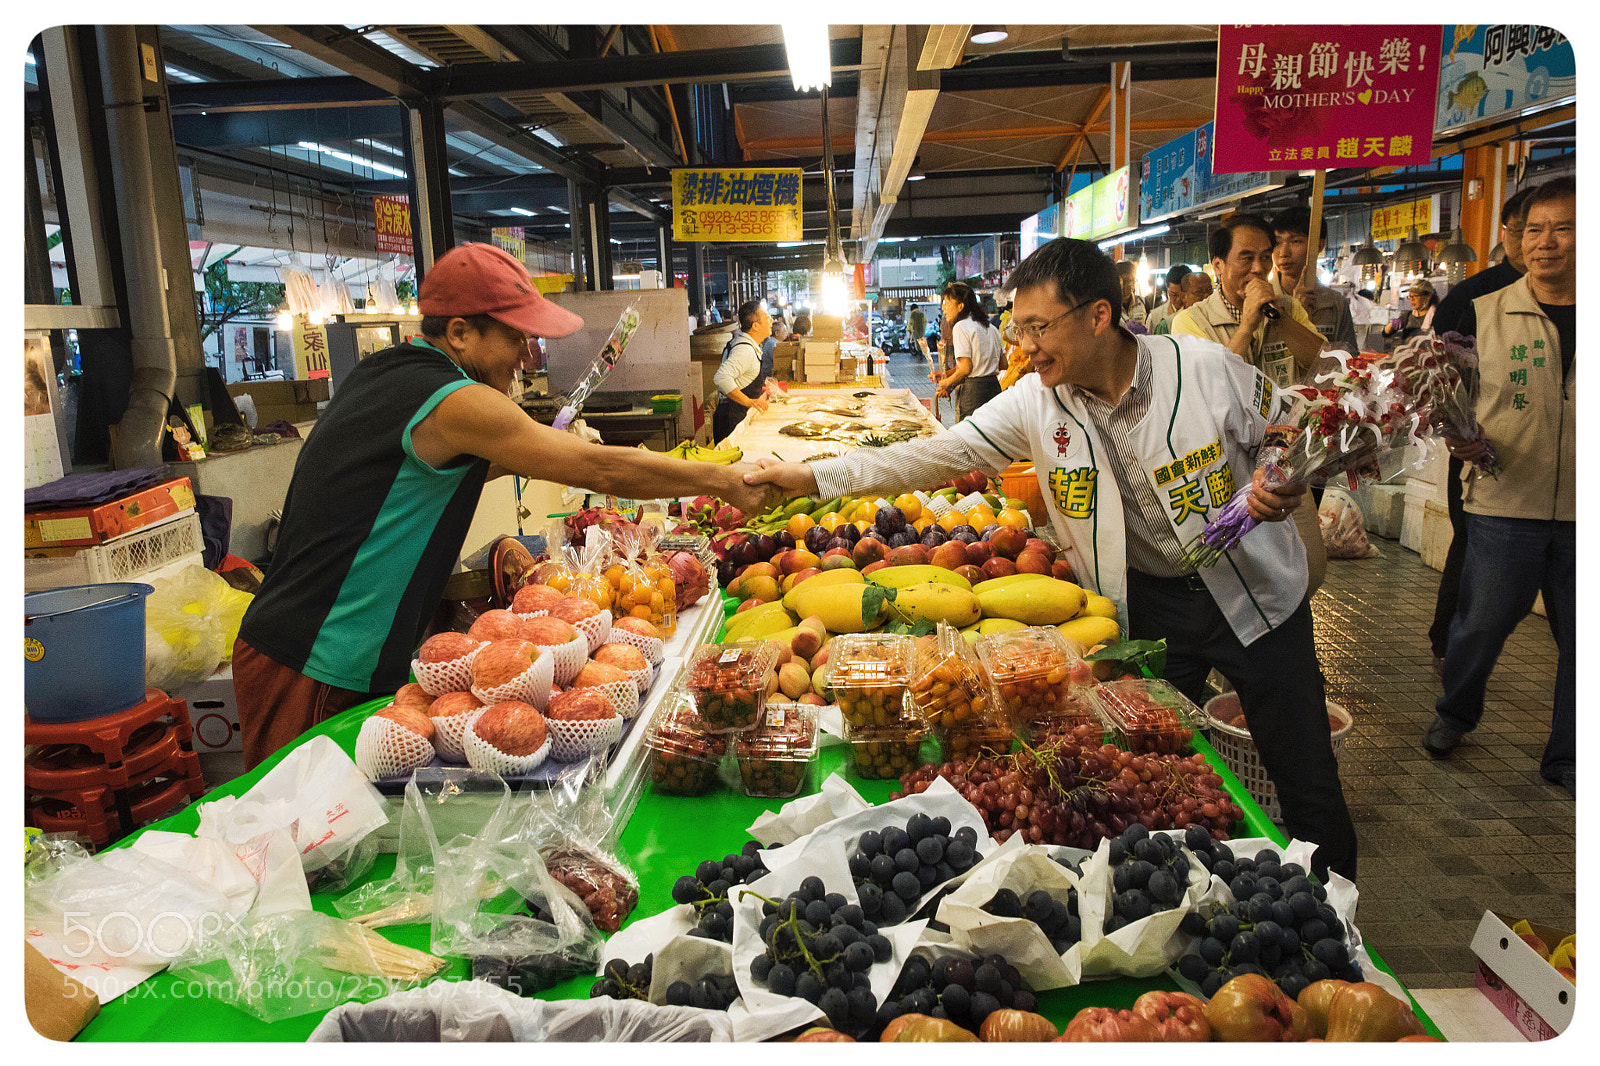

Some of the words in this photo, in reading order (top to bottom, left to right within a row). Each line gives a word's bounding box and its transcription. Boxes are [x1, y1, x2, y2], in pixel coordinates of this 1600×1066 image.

[1236, 37, 1427, 91] 母親節快樂!
[1237, 84, 1265, 96] Happy
[1263, 92, 1356, 109] MOTHER'S
[1374, 88, 1416, 104] DAY
[1268, 146, 1330, 162] 立法委員
[1336, 135, 1413, 159] 趙天麟
[681, 172, 699, 206] 清洗
[698, 172, 800, 206] 排油煙機
[1048, 466, 1099, 520] 趙
